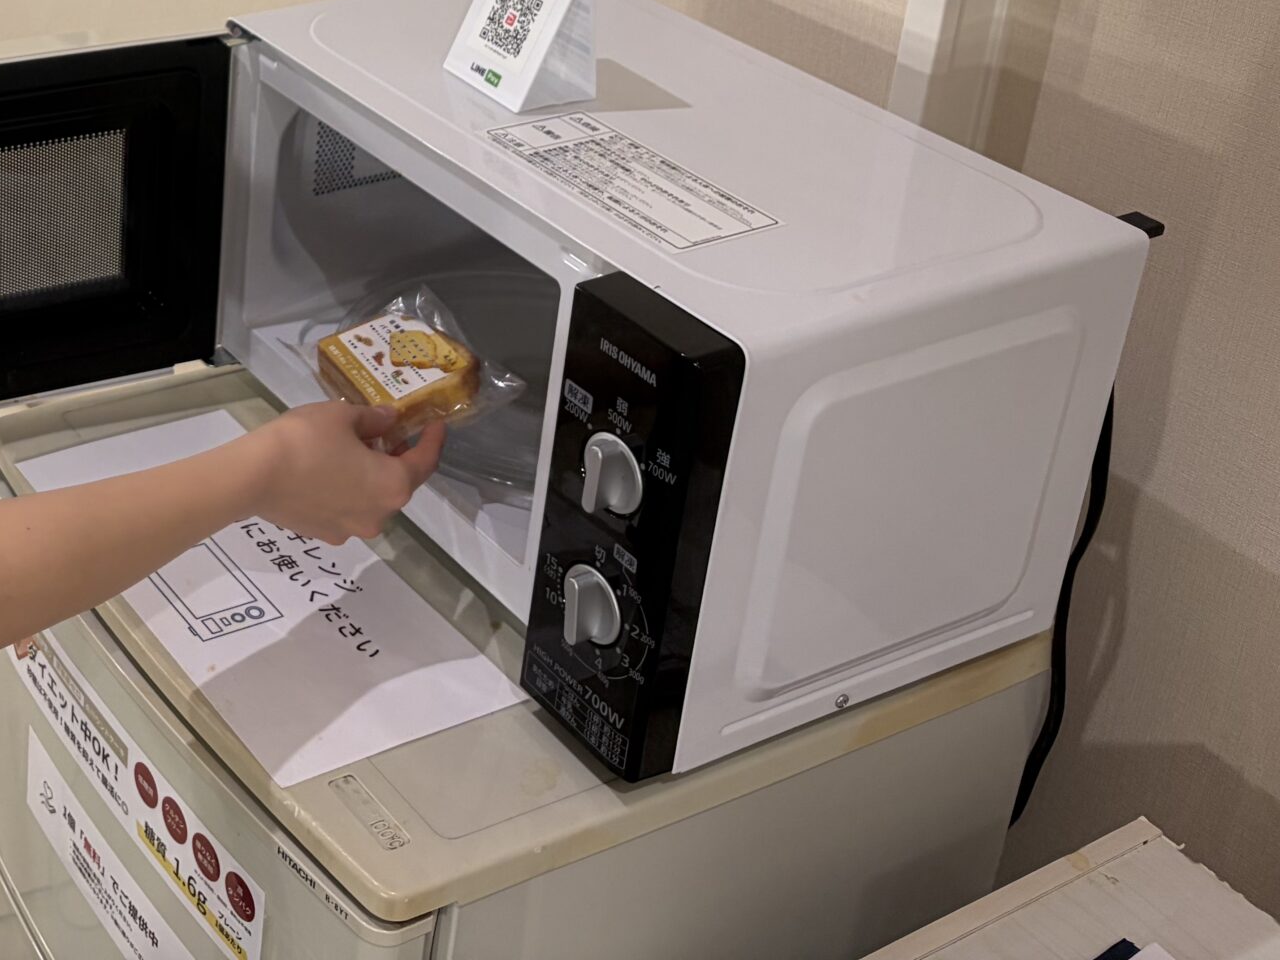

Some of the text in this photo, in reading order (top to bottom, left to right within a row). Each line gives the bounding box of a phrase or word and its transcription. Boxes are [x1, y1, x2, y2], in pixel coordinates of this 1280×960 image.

[470, 62, 486, 77] LINE
[600, 338, 657, 387] IRIS OHYAMA
[566, 381, 591, 411] 解凍
[616, 397, 628, 416] 弱
[564, 400, 588, 423] 200W
[608, 409, 632, 433] 500W
[656, 448, 671, 468] 強
[648, 461, 677, 485] 700W
[276, 525, 363, 593] 子レンジ
[545, 553, 558, 570] 15
[595, 545, 606, 563] 切
[545, 587, 557, 604] 10
[631, 625, 640, 639] 2
[595, 657, 602, 670] 4
[621, 655, 630, 668] 3
[533, 643, 554, 666] HIGH
[554, 662, 584, 695] POWER
[584, 685, 624, 730] 700W
[144, 821, 208, 916] 糖質 1.6g
[277, 846, 317, 889] HITACHI
